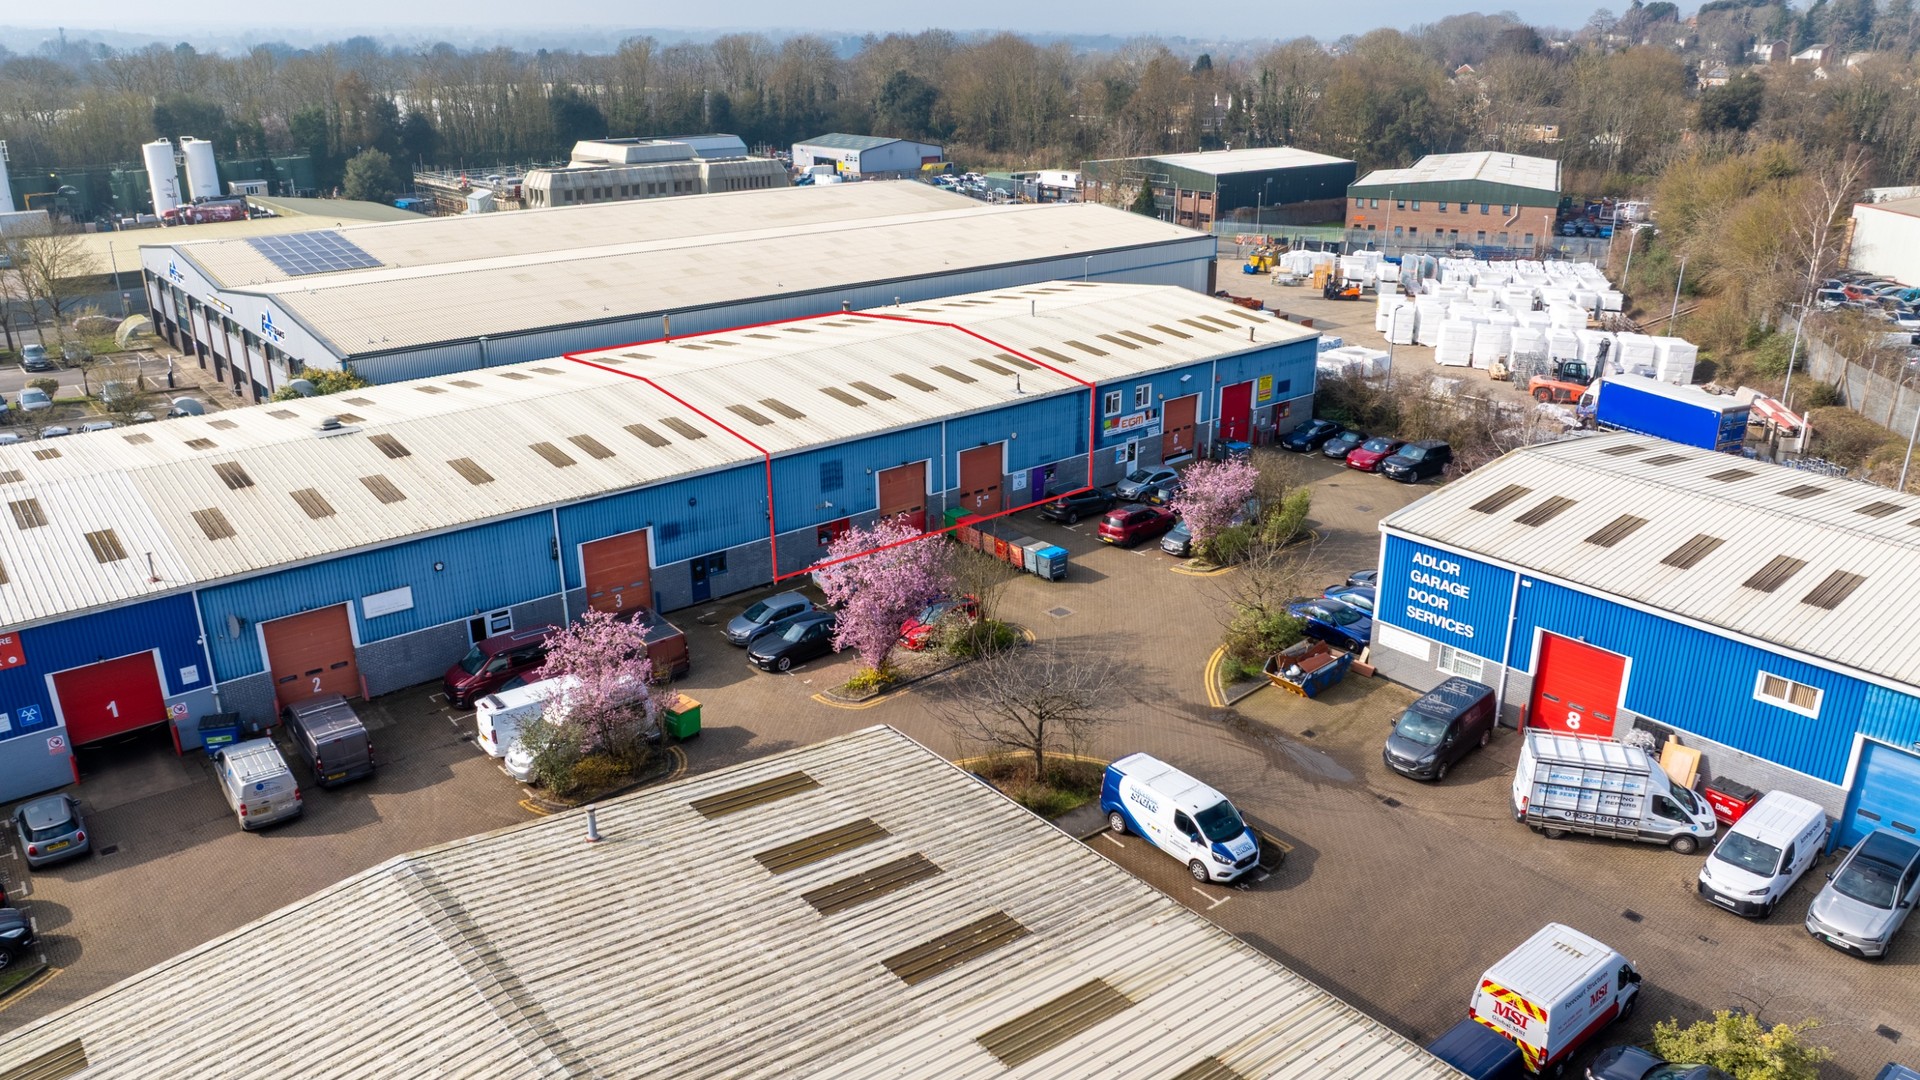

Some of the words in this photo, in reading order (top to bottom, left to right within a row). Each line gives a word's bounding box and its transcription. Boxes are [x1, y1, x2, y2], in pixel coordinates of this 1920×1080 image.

[1173, 433, 1179, 444] 6
[976, 496, 982, 507] 5
[1412, 551, 1461, 577] ADLOR
[1410, 569, 1470, 600] GARAGE
[615, 594, 623, 608] 3
[1408, 586, 1449, 611] DOOR
[1406, 605, 1474, 638] SERVICES
[312, 676, 322, 693] 2
[106, 700, 119, 718] 1
[1566, 711, 1581, 730] 8
[1130, 792, 1159, 814] SIGNS
[1589, 982, 1609, 1008] MSI
[1492, 1000, 1530, 1030] MSI
